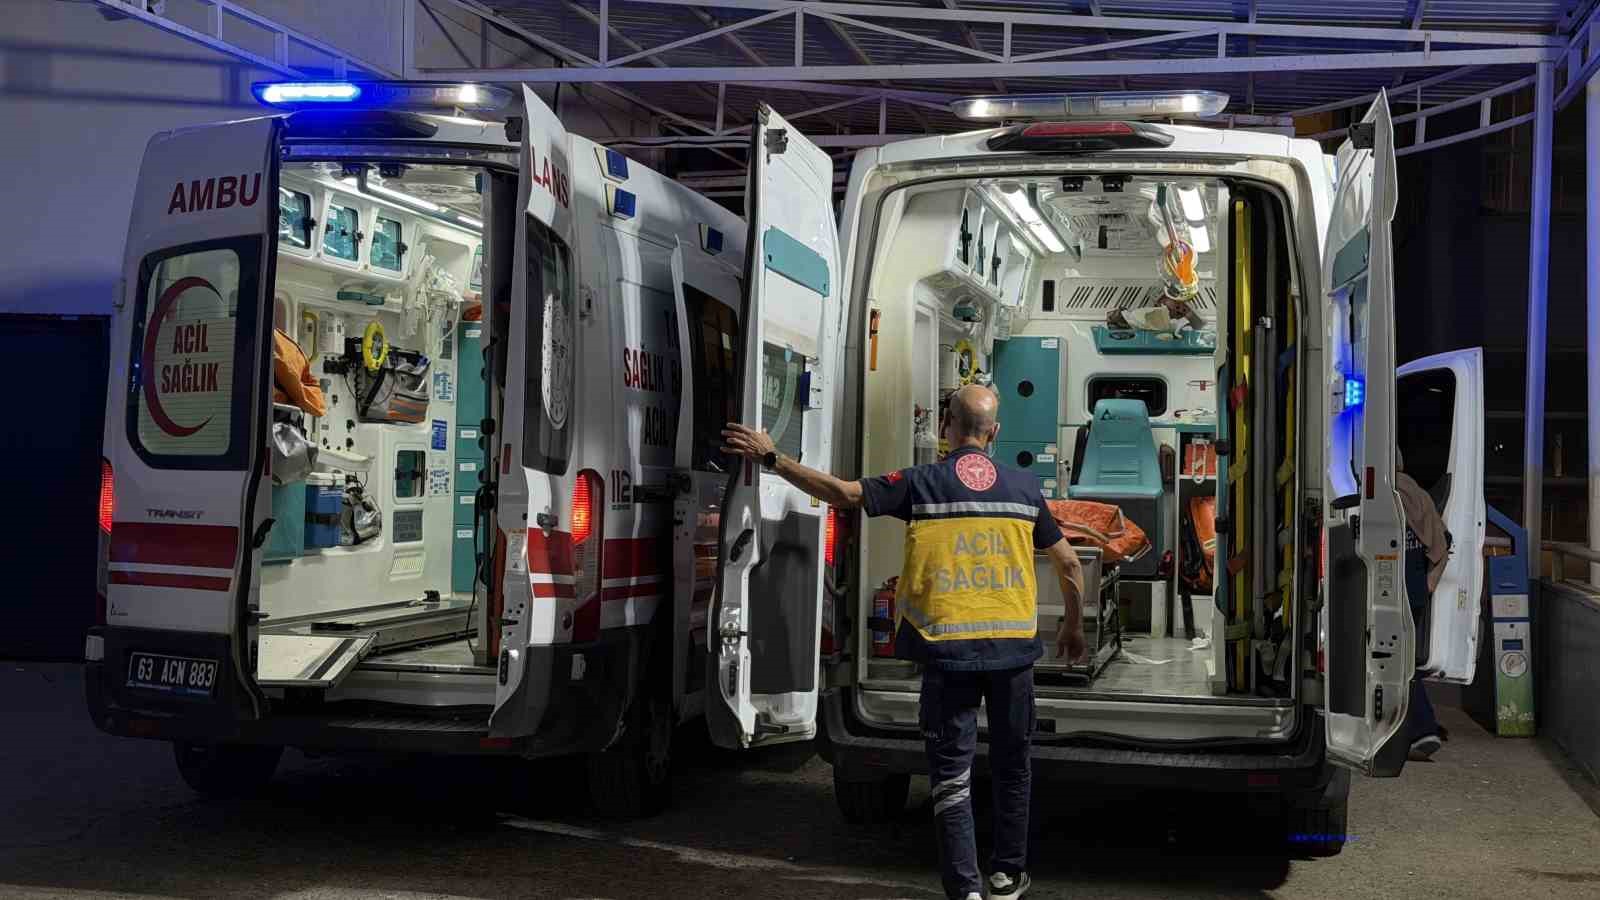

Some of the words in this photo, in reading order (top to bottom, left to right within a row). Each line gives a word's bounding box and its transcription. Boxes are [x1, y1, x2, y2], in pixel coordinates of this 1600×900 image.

[167, 172, 262, 215] AMBU
[530, 145, 569, 209] LANS
[173, 319, 209, 355] ACİL
[161, 358, 219, 393] SAĞLIK
[611, 469, 631, 504] 112
[935, 559, 1026, 593] SAĞLIK
[137, 657, 154, 681] 63
[160, 659, 186, 685] ACN
[188, 662, 214, 687] 883
